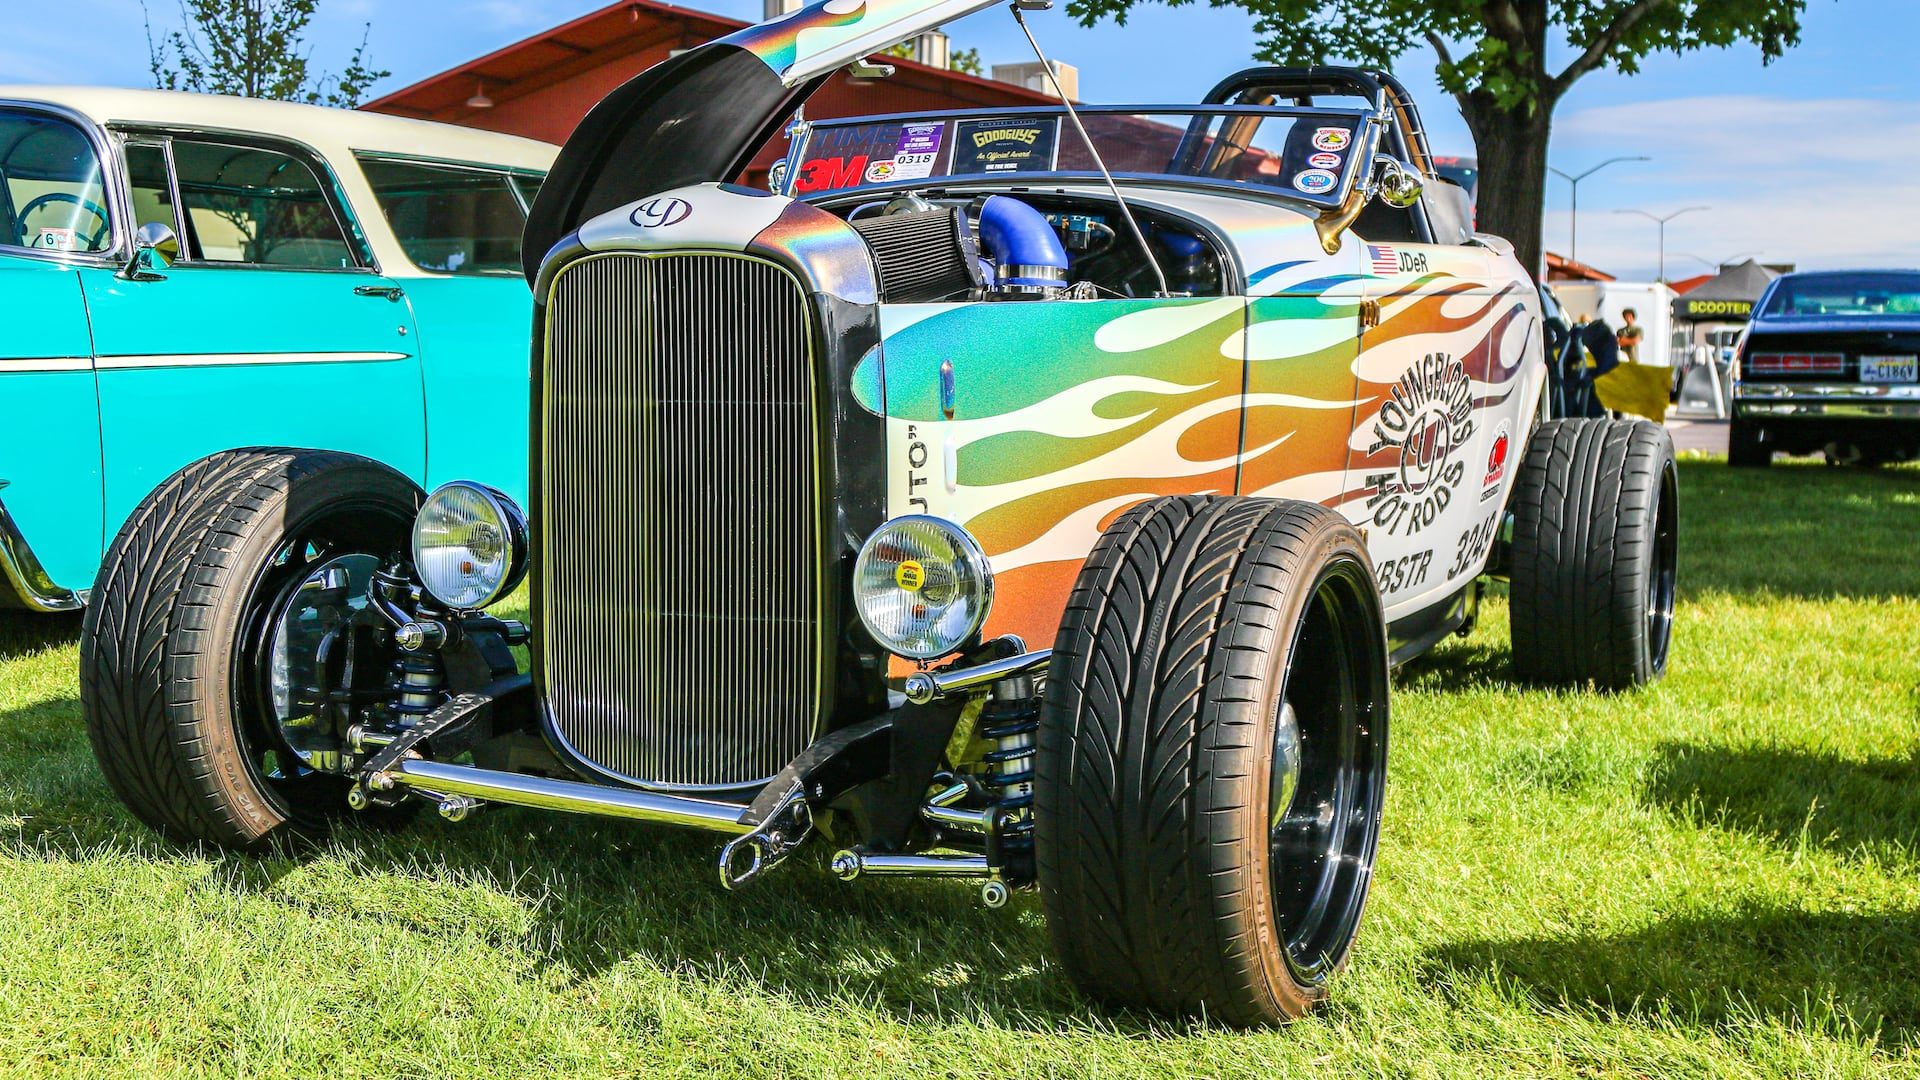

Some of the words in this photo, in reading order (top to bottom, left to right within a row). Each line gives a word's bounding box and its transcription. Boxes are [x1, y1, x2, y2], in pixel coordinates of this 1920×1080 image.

[973, 129, 1041, 147] GOODGUYS
[897, 154, 931, 165] 0318
[795, 154, 869, 191] 3M
[46, 233, 54, 245] 6
[1399, 252, 1429, 272] JDeR
[1689, 301, 1751, 314] SCOOTER
[1368, 352, 1474, 456] YOUNGBLOODS
[1365, 472, 1410, 536] HOT
[1406, 460, 1465, 536] RODS
[1447, 511, 1497, 581] 3249
